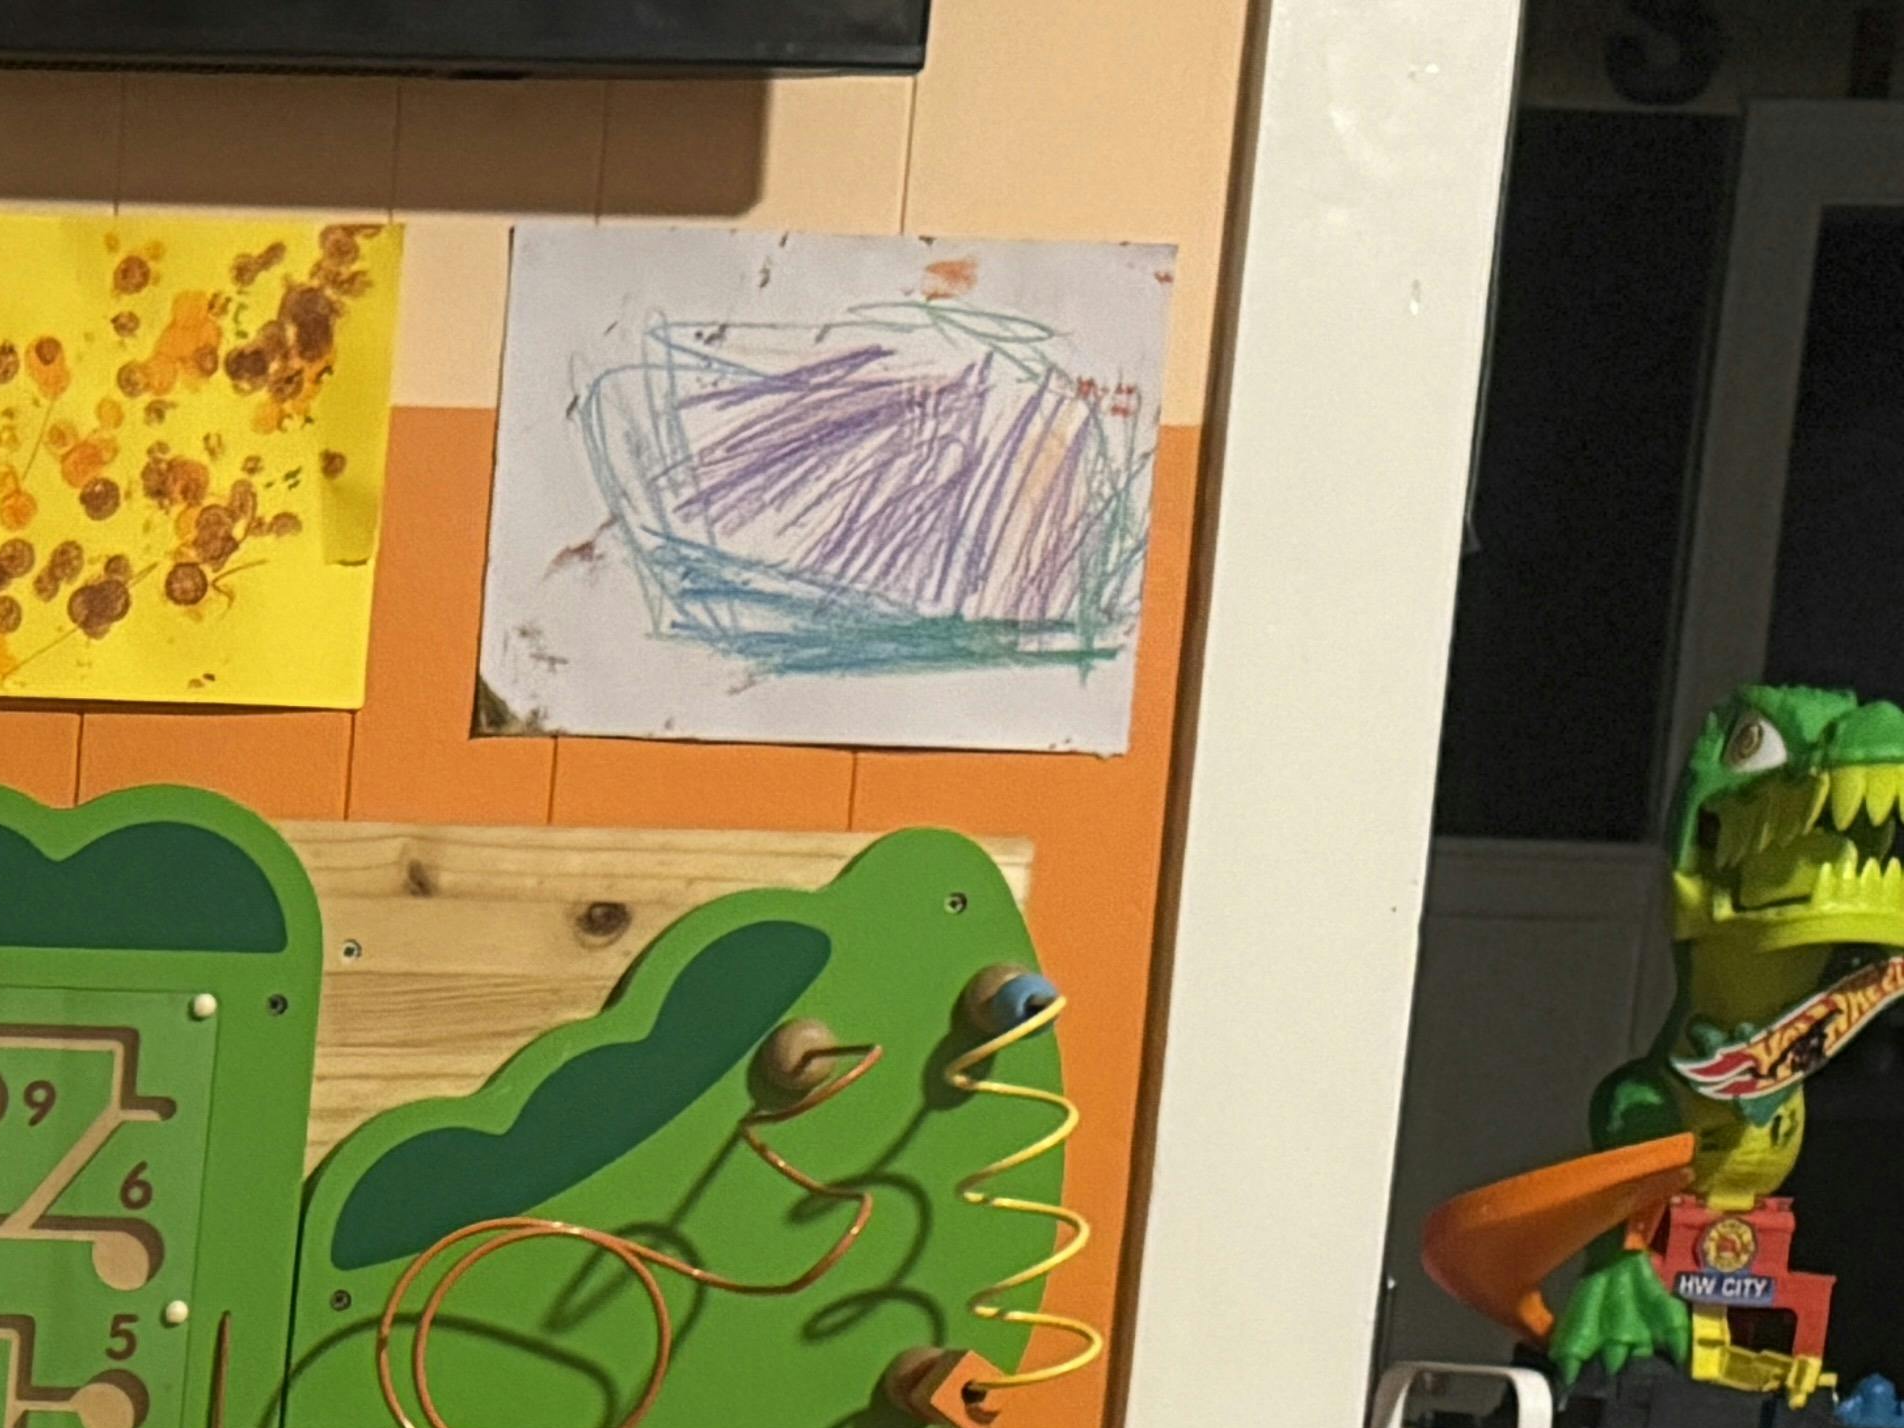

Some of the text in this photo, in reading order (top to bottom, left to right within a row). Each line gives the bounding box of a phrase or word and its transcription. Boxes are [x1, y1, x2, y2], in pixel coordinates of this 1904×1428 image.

[23, 1079, 57, 1127] 9
[119, 1161, 153, 1210] 6
[1679, 1275, 1767, 1298] HW CITY
[106, 1313, 139, 1361] 5
